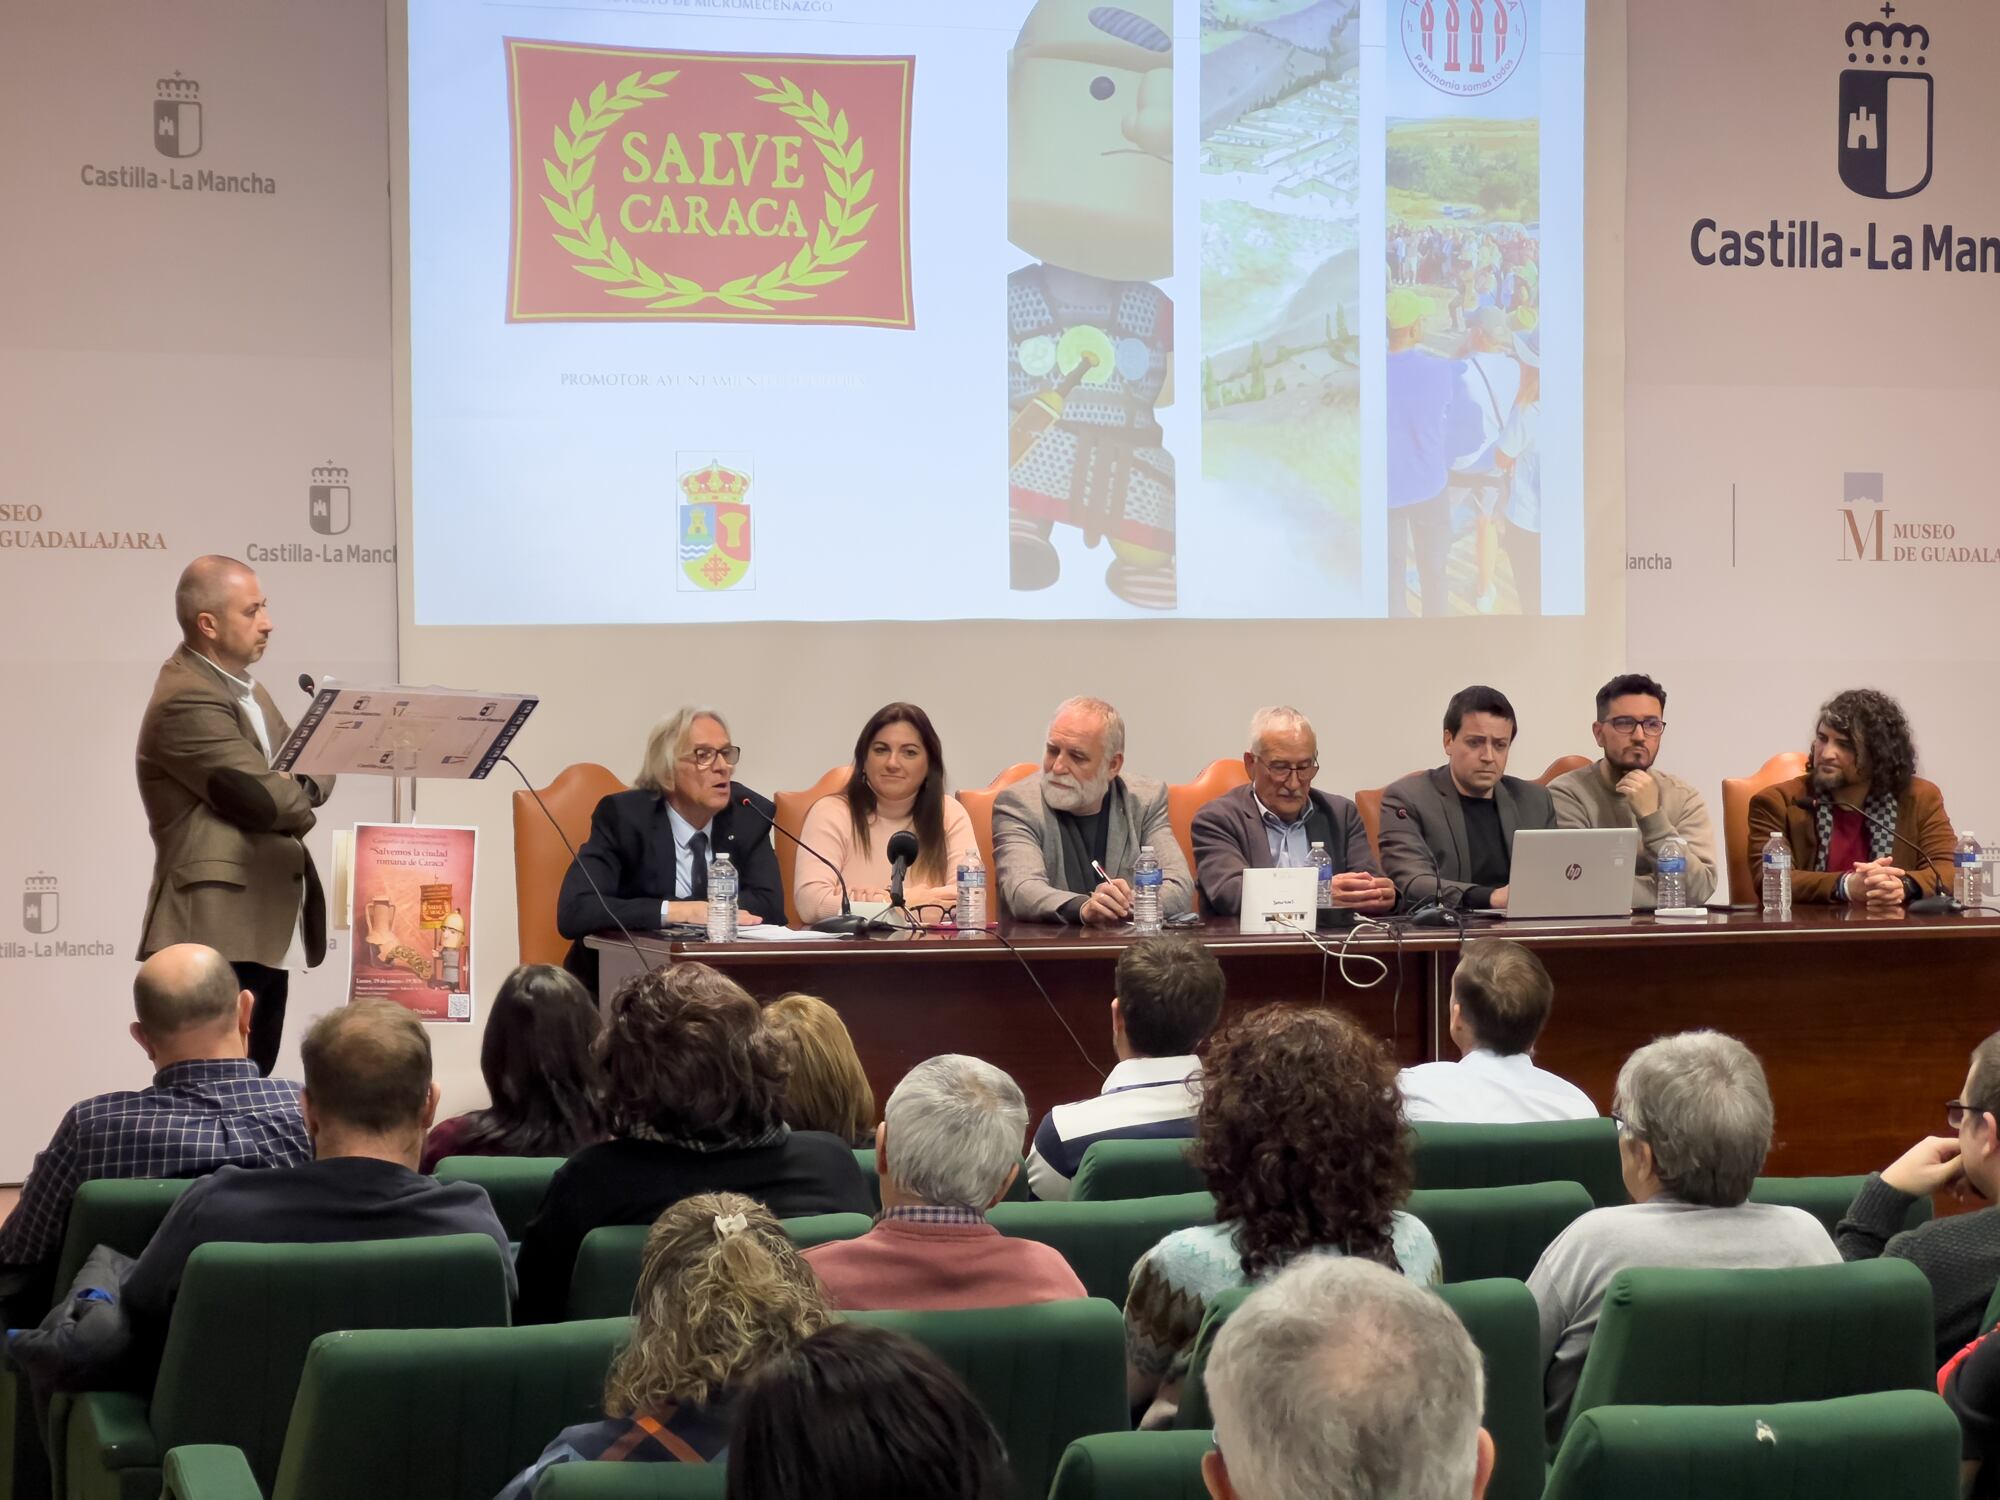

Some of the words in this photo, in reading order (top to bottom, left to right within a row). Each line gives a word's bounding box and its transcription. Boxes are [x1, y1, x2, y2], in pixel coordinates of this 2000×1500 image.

[1414, 54, 1460, 90] Patrimonio
[1463, 79, 1491, 92] somos
[1492, 59, 1514, 82] todos
[622, 131, 804, 188] SALVE
[198, 169, 276, 194] Mancha
[620, 194, 808, 237] CARACA
[560, 373, 649, 386] PROMOTOR
[0, 504, 43, 521] SEO
[0, 530, 168, 550] GUADALAJARA
[1893, 523, 1955, 539] MUSEO
[1625, 552, 1672, 570] ancha
[1894, 546, 1917, 562] DE
[1565, 863, 1583, 881] hp
[55, 940, 114, 957] Mancha
